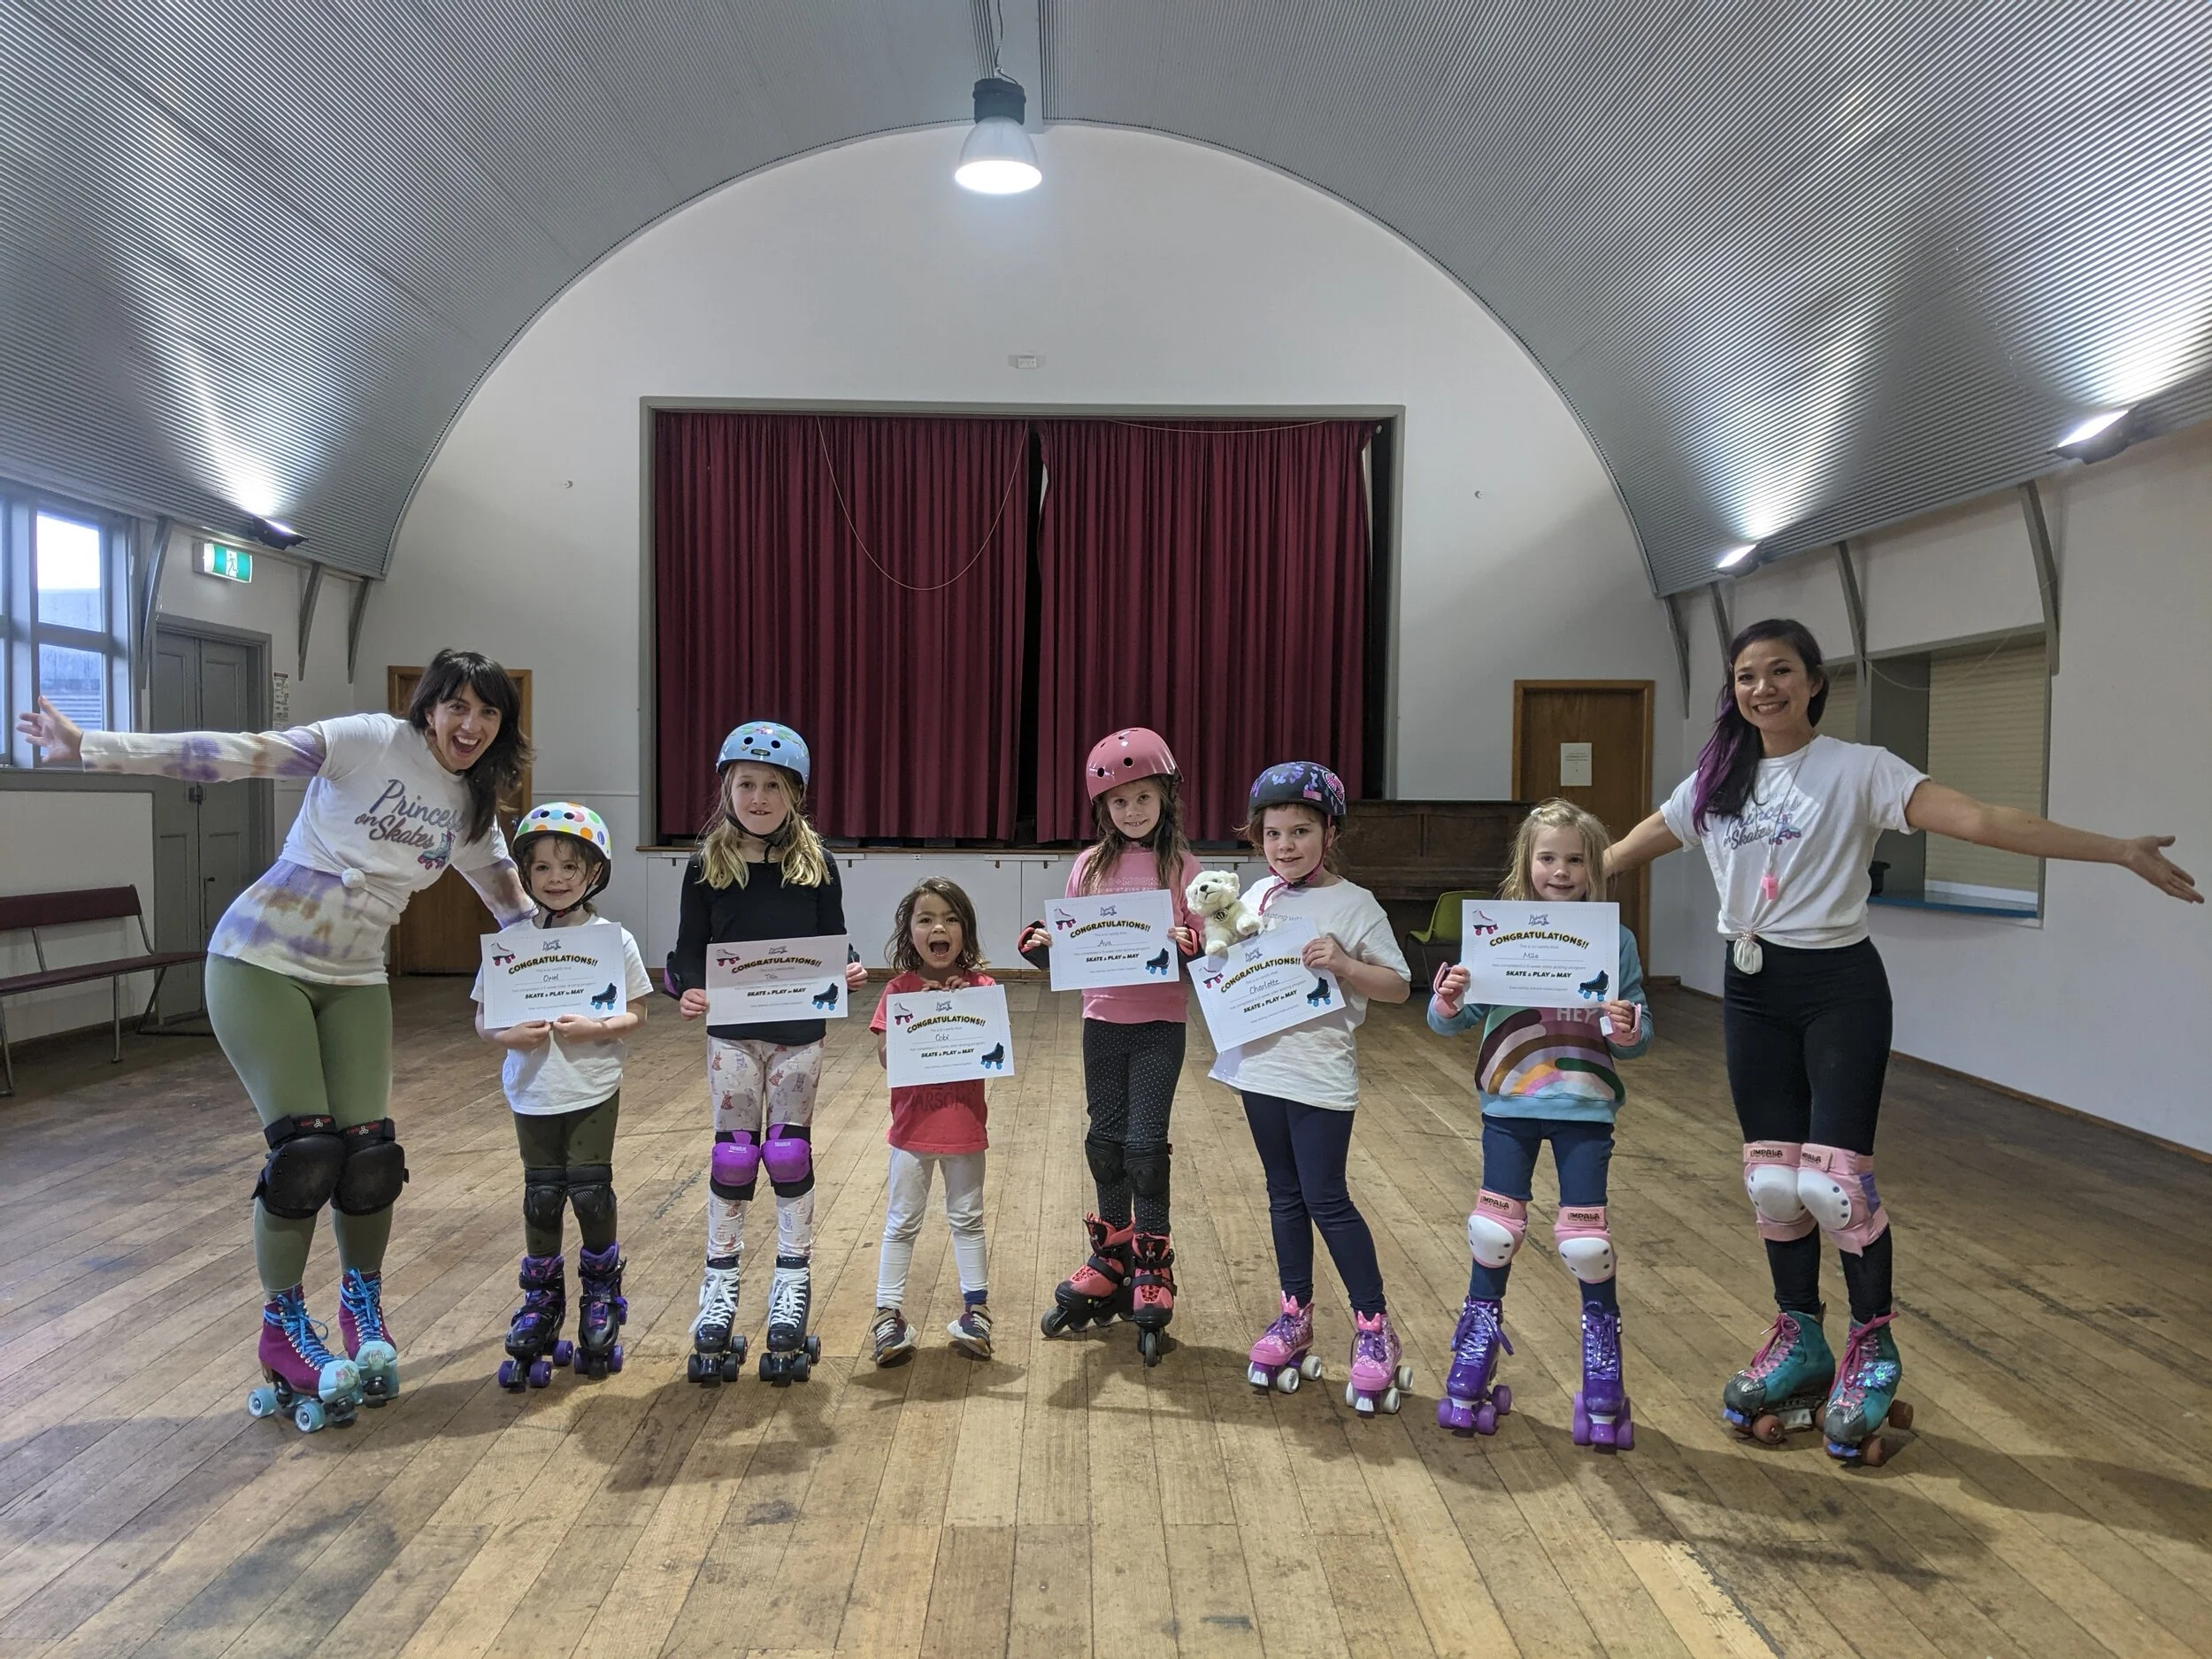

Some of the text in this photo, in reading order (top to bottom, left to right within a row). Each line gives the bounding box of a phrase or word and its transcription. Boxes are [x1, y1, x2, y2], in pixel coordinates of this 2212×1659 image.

[354, 813, 435, 849] on Skates
[1070, 920, 1151, 939] CONGRATULATIONS!!
[1489, 931, 1590, 949] CONGRATULATIONS!!
[508, 955, 598, 974] CONGRATULATIONS!!
[731, 956, 822, 974] CONGRATULATIONS!!
[1220, 957, 1302, 994] CONGRATULATIONS!!
[1248, 979, 1280, 995] Charlotte
[1243, 1003, 1261, 1014] SKATE
[1265, 995, 1279, 1005] PLAY
[1285, 989, 1297, 999] MAY
[907, 1015, 986, 1033] CONGRATULATIONS!!
[1753, 1149, 1783, 1158] IMPALA
[1482, 1195, 1509, 1210] IMPALA
